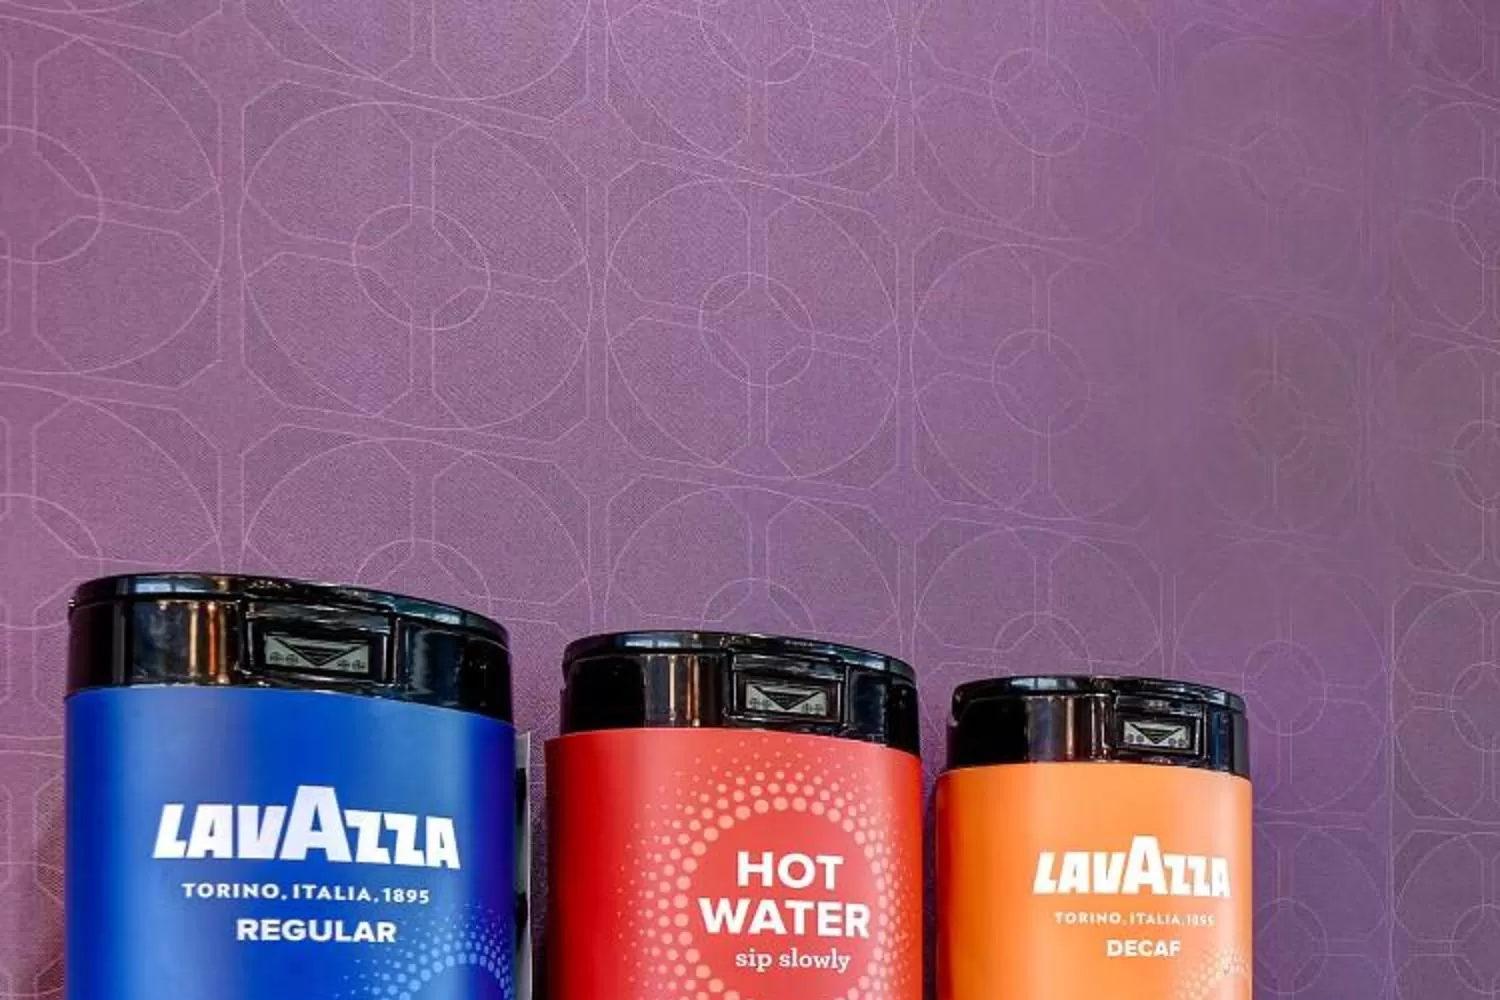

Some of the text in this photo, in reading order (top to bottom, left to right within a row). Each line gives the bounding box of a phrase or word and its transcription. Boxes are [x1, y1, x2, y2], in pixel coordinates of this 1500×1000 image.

[153, 785, 461, 869] LAVAZZA
[736, 850, 844, 889] HOT
[1033, 835, 1231, 897] LAVAZZA
[381, 888, 429, 904] 1895
[236, 918, 397, 943] REGULAR
[698, 897, 870, 938] WATER
[735, 948, 851, 974] sip slowly
[1106, 939, 1181, 957] DECAF
